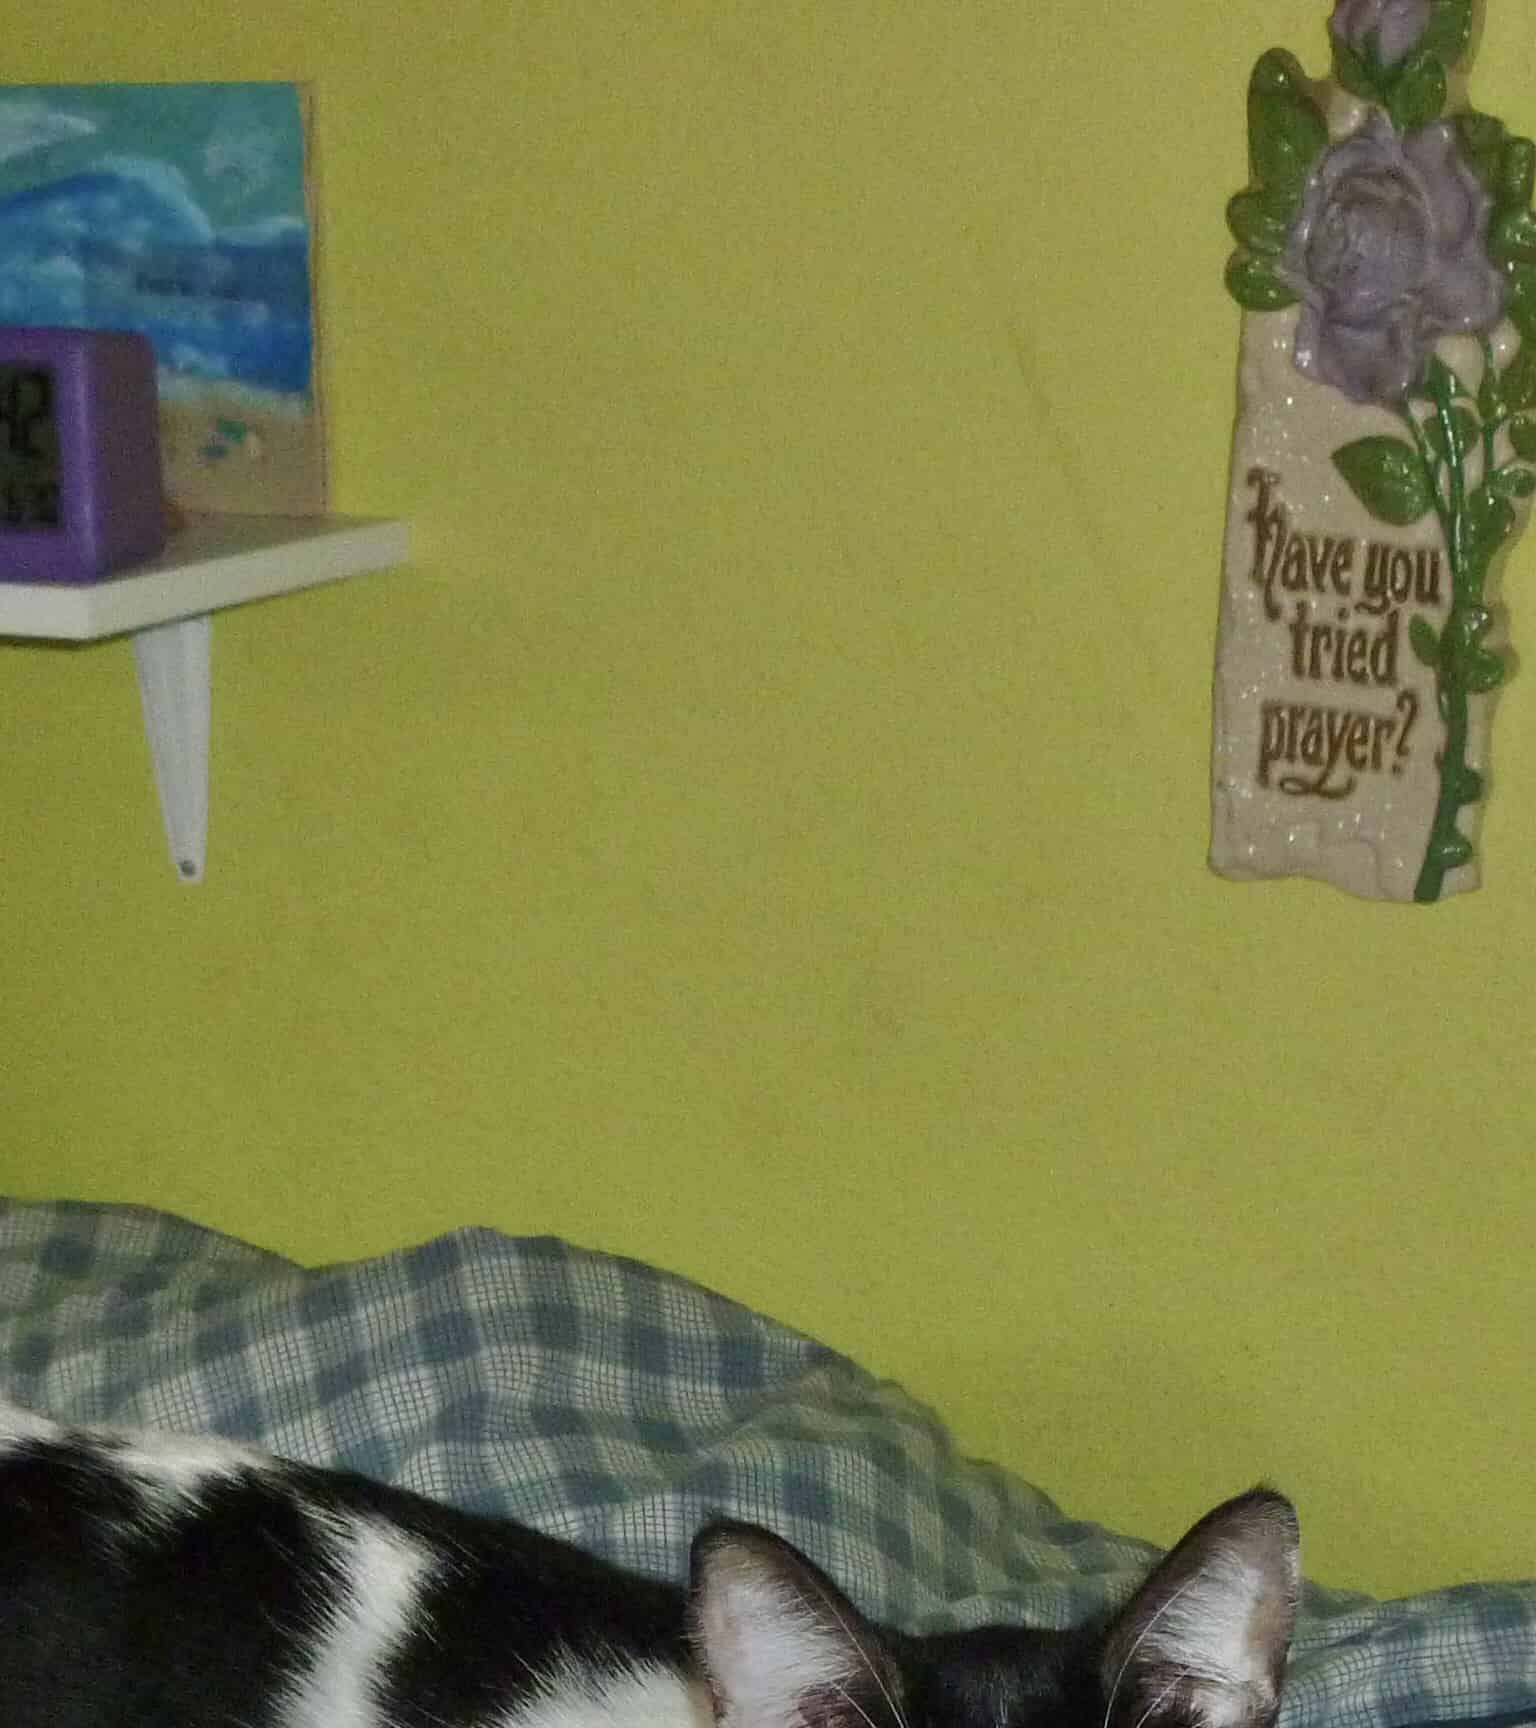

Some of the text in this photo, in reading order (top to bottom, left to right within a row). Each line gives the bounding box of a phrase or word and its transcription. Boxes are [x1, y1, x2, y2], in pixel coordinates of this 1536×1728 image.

[1354, 543, 1441, 614] you
[1290, 601, 1400, 685] tried
[1257, 689, 1419, 798] prayer?
